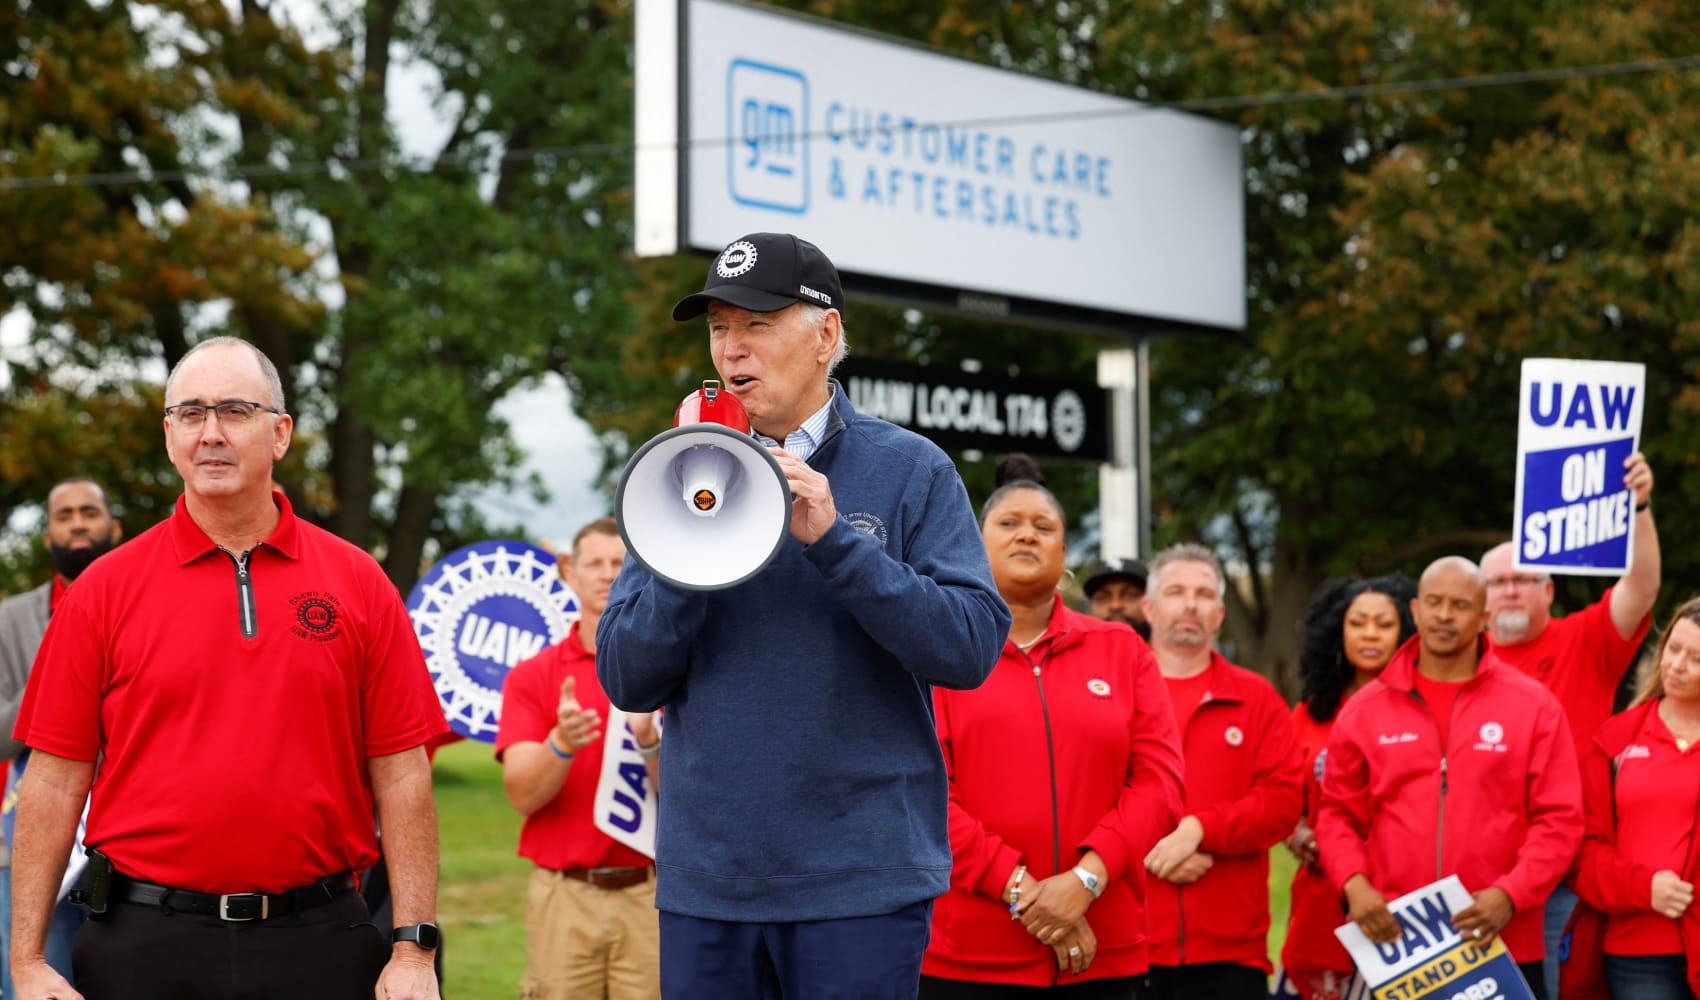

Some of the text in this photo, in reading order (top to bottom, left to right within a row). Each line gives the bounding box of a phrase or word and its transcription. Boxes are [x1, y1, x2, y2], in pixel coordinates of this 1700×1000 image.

[742, 98, 794, 170] gm
[825, 102, 1112, 197] CUSTOMER CARE
[827, 156, 1081, 240] & AFTERSALES
[725, 254, 746, 264] UAW
[800, 284, 820, 300] UNION
[848, 375, 1048, 439] UAW LOCAL 174
[1530, 381, 1636, 431] UAW
[1560, 448, 1606, 503] ON
[1523, 490, 1628, 560] STRIKE
[306, 611, 327, 621] UAW
[458, 612, 546, 668] UAW
[1385, 960, 1457, 1000] STAND
